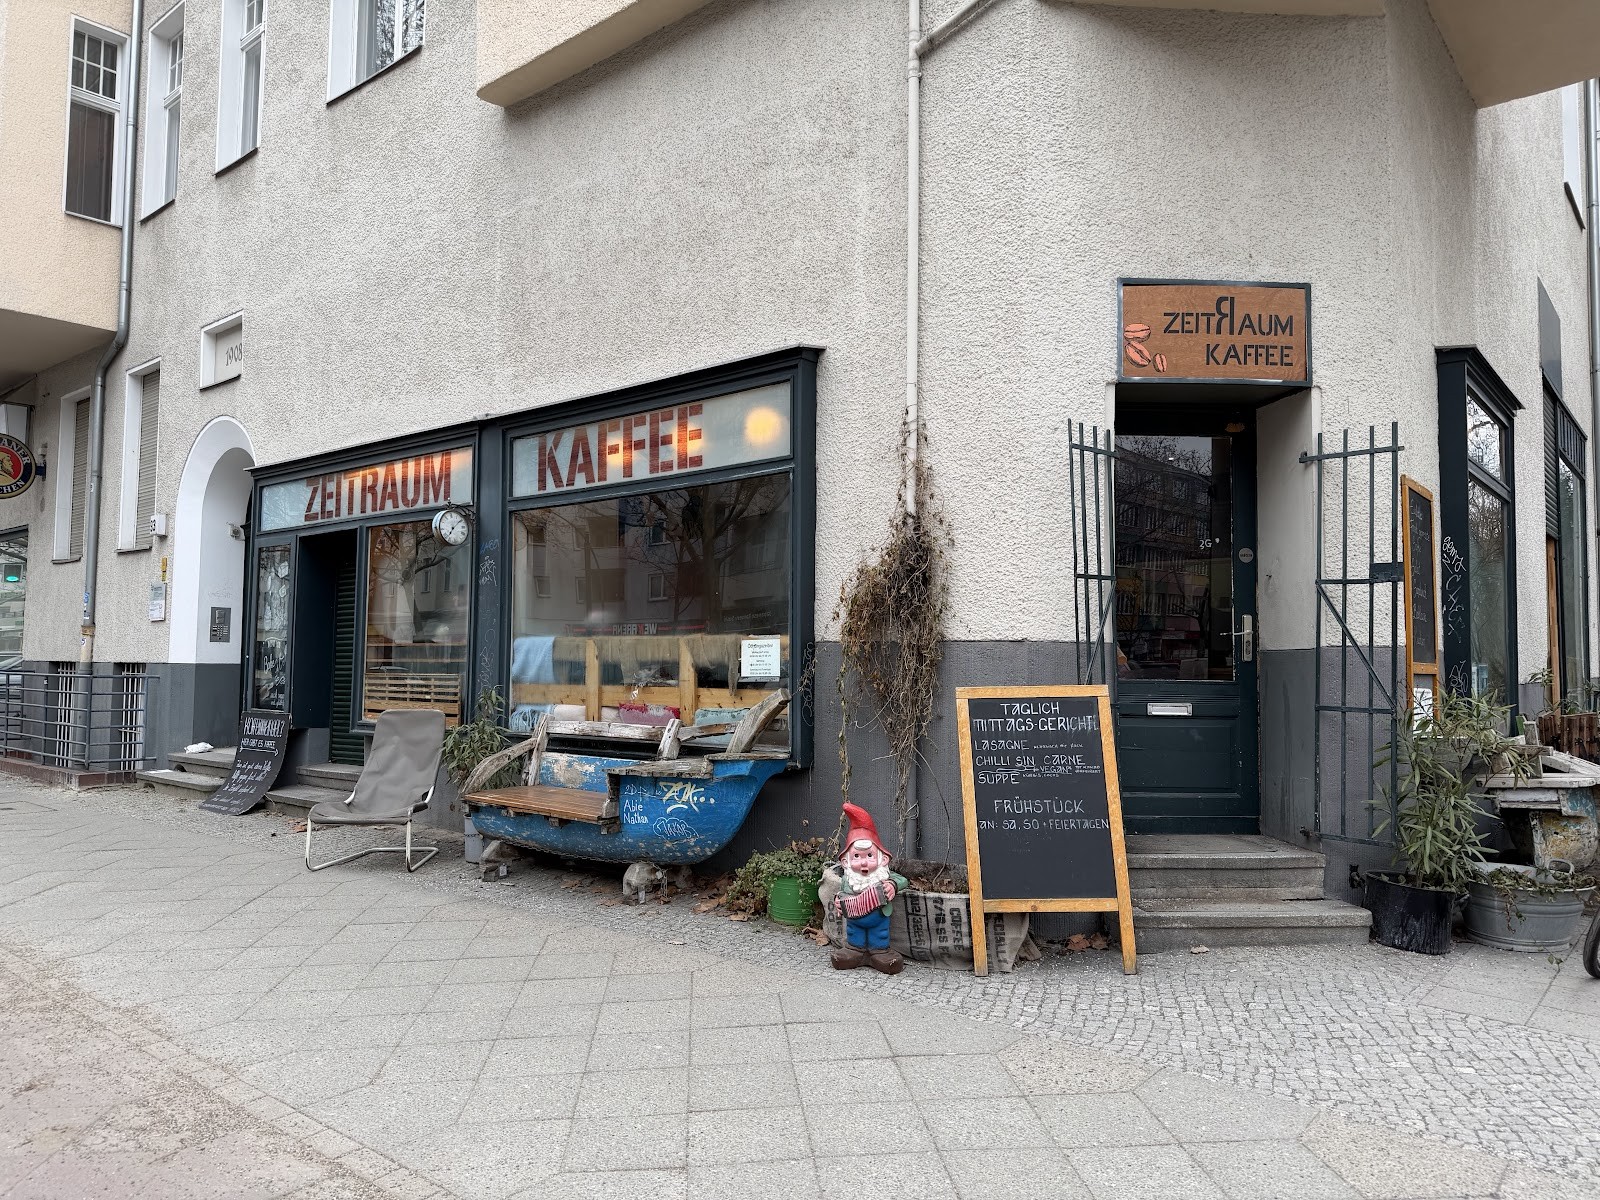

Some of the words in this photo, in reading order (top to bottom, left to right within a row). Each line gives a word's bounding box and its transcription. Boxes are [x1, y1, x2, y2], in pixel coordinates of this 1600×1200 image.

[1163, 296, 1293, 337] ZEITRAUM
[225, 342, 242, 366] 1908
[1205, 343, 1293, 366] KAFFEE
[0, 438, 31, 465] ANER
[537, 403, 703, 491] KAFFEE
[304, 451, 451, 522] ZEITRAUM
[974, 739, 1030, 751] LASAGNE
[975, 755, 1010, 767] CHILLI
[1015, 755, 1035, 766] SIN
[1043, 754, 1086, 765] CARNE
[978, 772, 1020, 784] SUPPE
[623, 799, 644, 812] Abie
[993, 795, 1085, 814] FRÜHSTÜCK
[623, 812, 649, 825] Nathan
[1049, 818, 1109, 830] FEIERTAGEN
[949, 907, 964, 951] COFFEE
